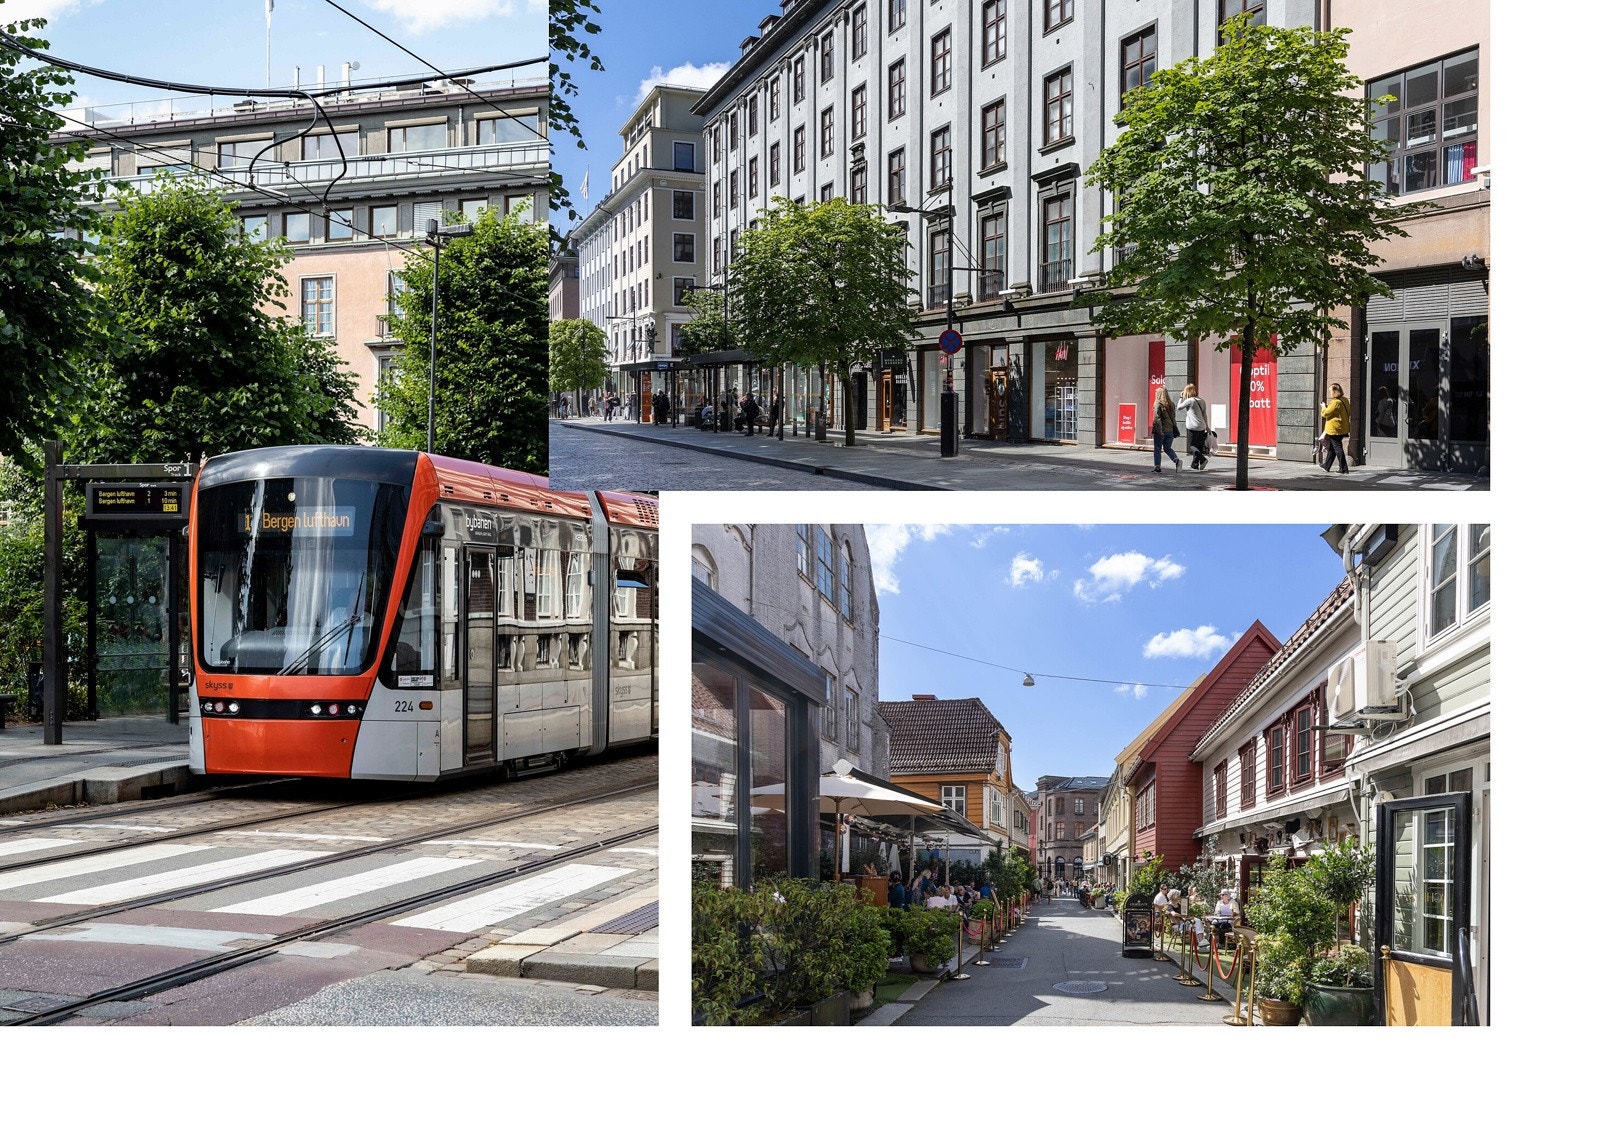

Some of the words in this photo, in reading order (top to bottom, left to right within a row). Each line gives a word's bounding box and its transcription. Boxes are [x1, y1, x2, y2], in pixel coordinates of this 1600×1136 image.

[1250, 380, 1265, 392] 0%
[1249, 397, 1271, 408] batt
[163, 464, 182, 472] Spor
[183, 462, 192, 477] 1
[98, 490, 116, 498] Bergen
[262, 512, 301, 532] Bergen
[303, 511, 350, 528] lufthavn
[465, 514, 492, 531] bybanen
[205, 680, 227, 691] skyss
[394, 700, 414, 713] 224
